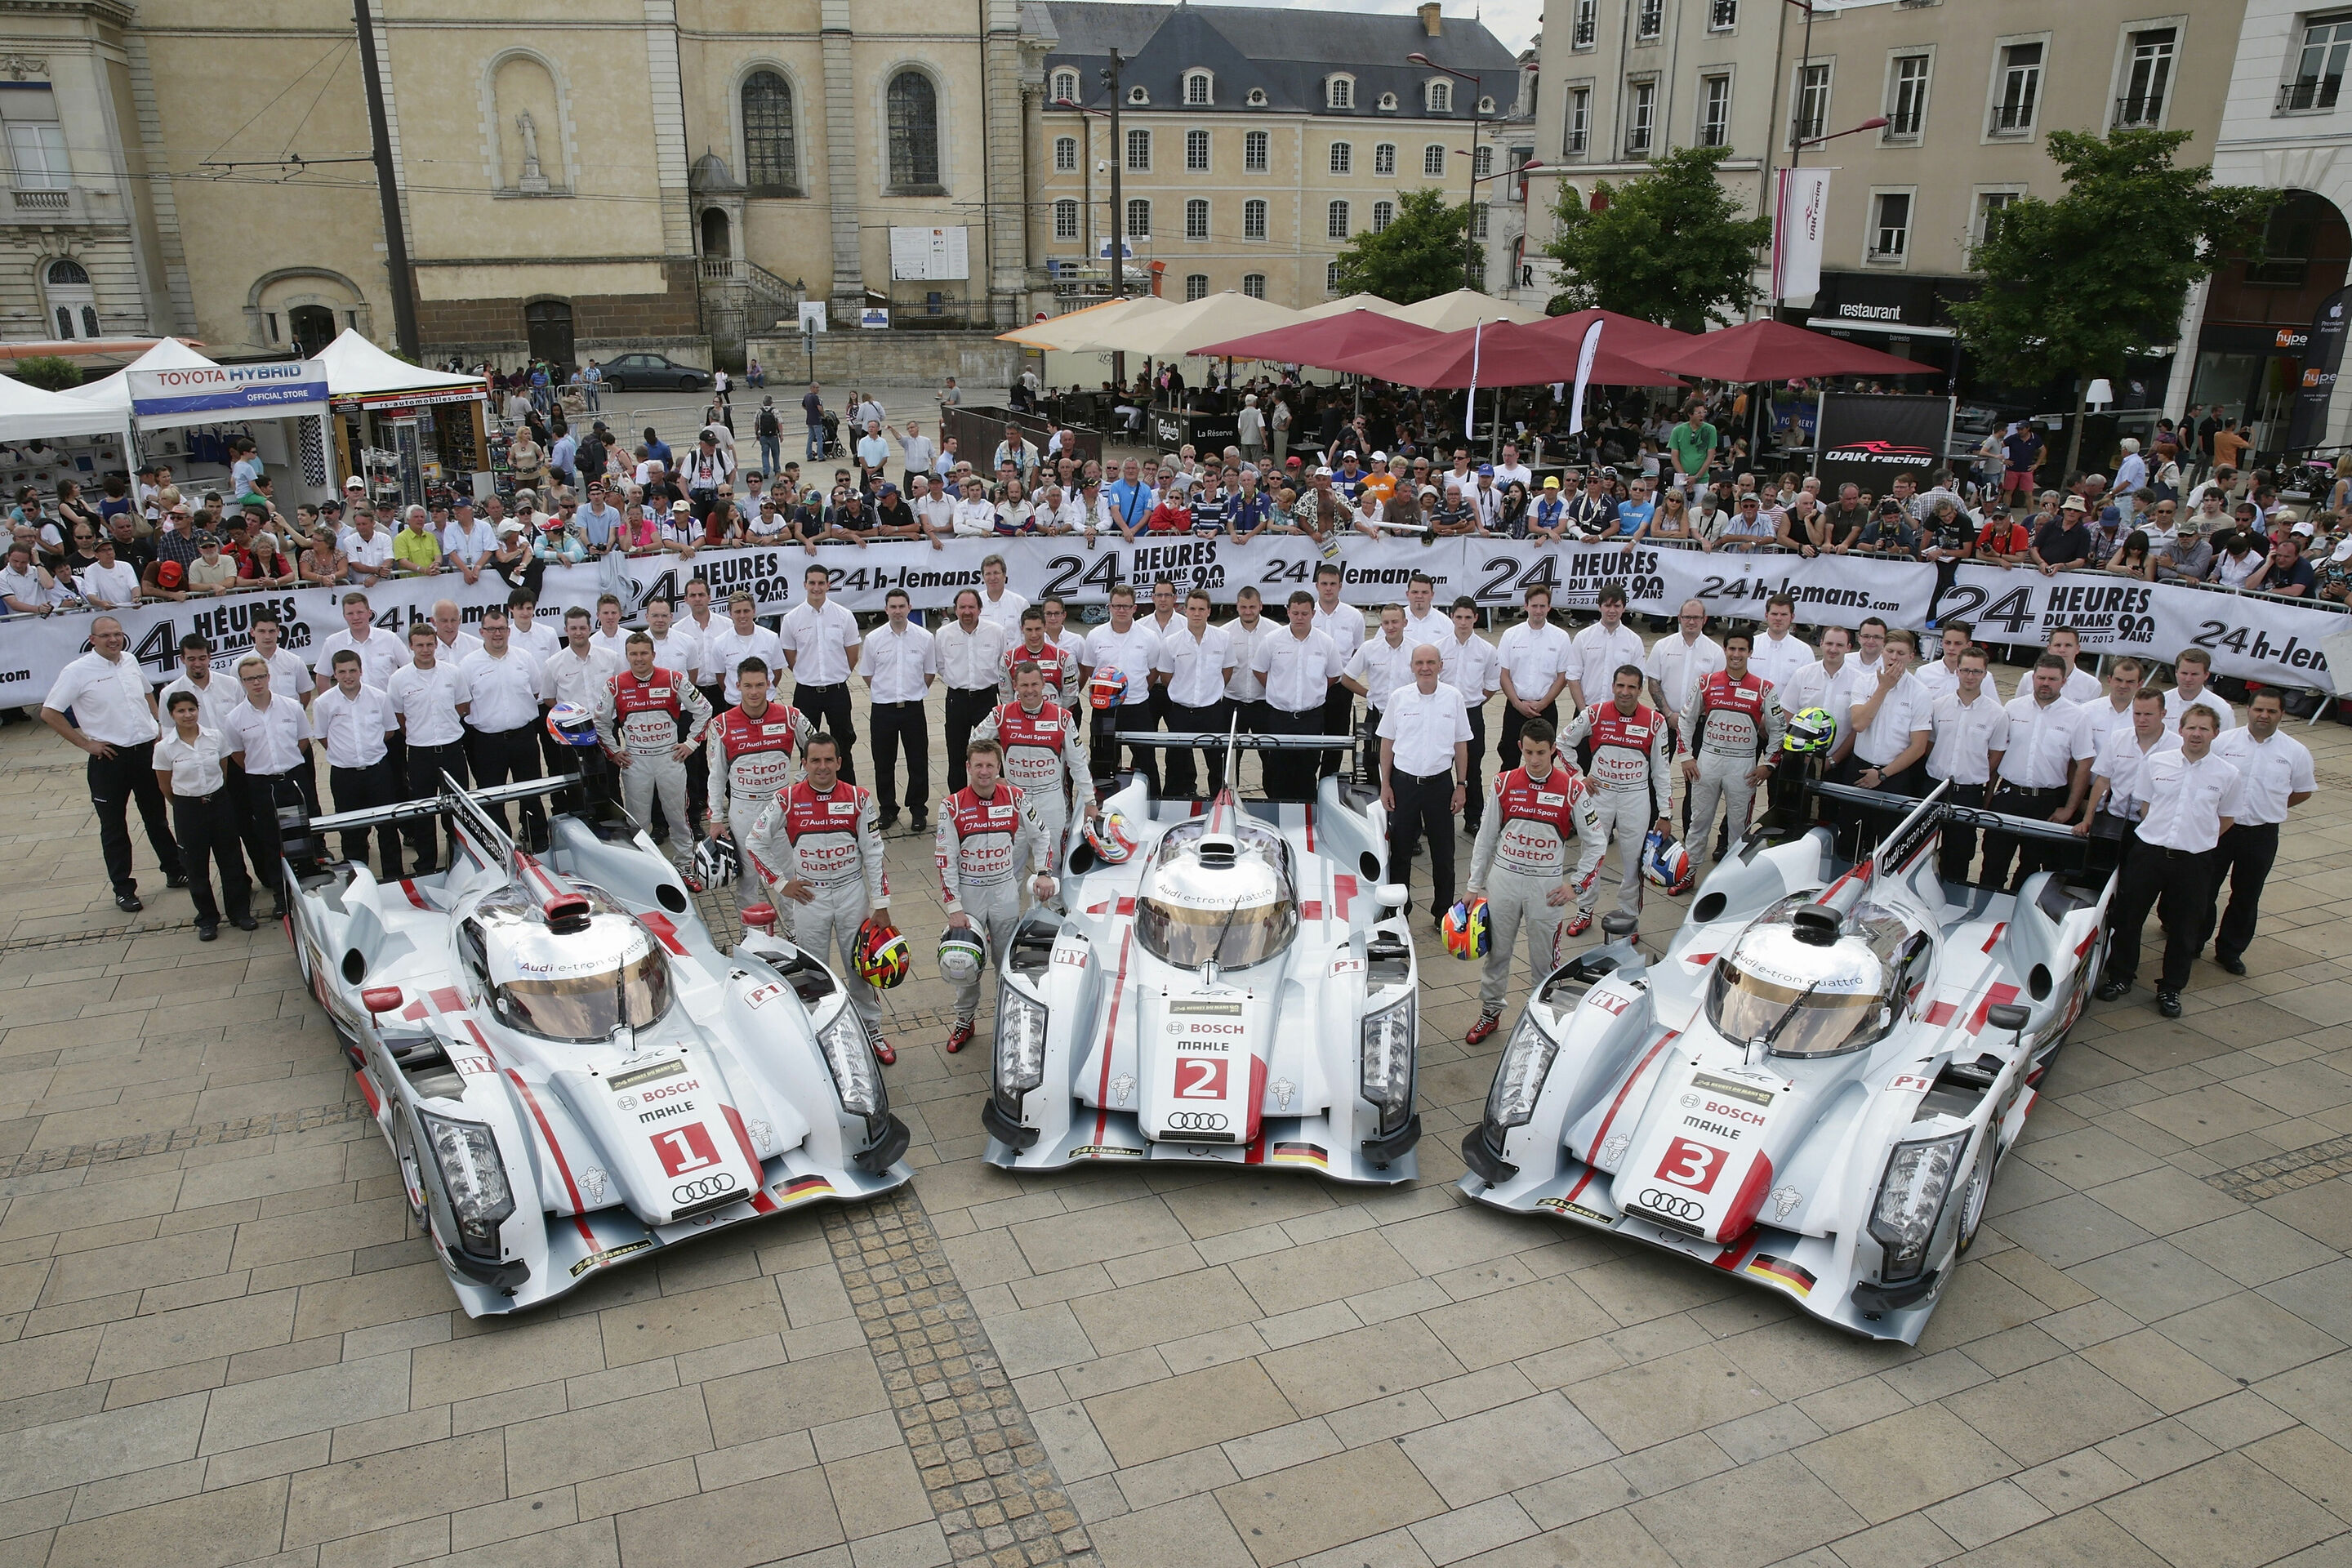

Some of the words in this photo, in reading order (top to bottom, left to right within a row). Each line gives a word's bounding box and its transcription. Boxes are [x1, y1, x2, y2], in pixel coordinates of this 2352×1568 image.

[1814, 180, 1822, 214] racing
[1521, 265, 1534, 287] R
[1839, 303, 1901, 320] restaurant
[1830, 329, 1851, 337] baresto
[2276, 330, 2308, 346] hype
[158, 370, 226, 386] TOYOTA
[229, 364, 302, 381] HYBRID
[2303, 370, 2337, 385] hype
[247, 391, 283, 403] OFFICIAL
[283, 389, 309, 399] STORE
[380, 394, 474, 408] rs-automobiles.com
[1158, 418, 1179, 437] Carlsberg
[1781, 416, 1815, 428] POMERY
[1197, 430, 1205, 438] La
[1207, 429, 1233, 438] Réserve
[1825, 451, 1870, 462] OAK
[1871, 455, 1932, 467] racing
[693, 553, 779, 586] HEURES
[1039, 551, 1126, 599] 24
[1134, 541, 1217, 572] HEURES
[1152, 568, 1188, 583] MANS
[1192, 564, 1224, 590] 90
[1259, 558, 1309, 583] 24
[1313, 560, 1448, 586] lemansom
[1473, 554, 1561, 601] 24
[1571, 551, 1659, 576] HEURES
[828, 568, 870, 592] 24
[873, 567, 1008, 590] h-lemans.
[1133, 573, 1150, 585] DU
[1204, 577, 1224, 589] ANS
[1568, 578, 1587, 590] DU
[1592, 577, 1628, 590] MANS
[755, 577, 789, 603] 90
[767, 588, 789, 602] ANS
[1632, 576, 1664, 599] 90
[1642, 588, 1664, 599] ANS
[1695, 577, 1750, 600] 24
[1751, 577, 1900, 612] h-lemans.com
[1568, 596, 1590, 605] 22-23
[409, 603, 560, 624] h-man.com
[1938, 585, 2037, 634] 24
[2047, 586, 2153, 613] HEURES
[2042, 613, 2066, 627] DU
[2070, 613, 2114, 627] MANS
[2118, 616, 2154, 642] 90
[2128, 629, 2154, 644] ANS
[2190, 620, 2252, 654] 24
[224, 633, 252, 650] MAN
[287, 635, 311, 650] ANS
[2092, 633, 2115, 644] 2013
[627, 721, 670, 733] e-tron
[1707, 720, 1751, 733] e-tron
[629, 732, 671, 743] quattro
[1707, 731, 1750, 743] quattro
[737, 762, 786, 775] e-tron
[1009, 757, 1054, 768] e-tron
[1597, 756, 1643, 769] e-tron
[737, 773, 786, 786] quattro
[1009, 768, 1055, 779] quattro
[1597, 768, 1642, 780] quattro
[1537, 809, 1558, 817] Sport
[464, 811, 482, 838] e-tron
[482, 831, 506, 865] quattro
[1505, 831, 1557, 849] e-tron
[1882, 844, 1900, 875] Audi
[1900, 827, 1919, 855] e-tron
[1920, 804, 1943, 835] quattro
[800, 844, 855, 859] e-tron
[960, 845, 1011, 859] e-tron
[1502, 844, 1555, 862] quattro
[801, 857, 856, 871] quattro
[960, 859, 1010, 872] quattro
[1157, 883, 1182, 899] Audi
[1183, 894, 1223, 905] e-tron
[1230, 888, 1272, 906] quattro
[520, 962, 554, 973] Audi
[558, 959, 605, 972] e-tron
[608, 938, 644, 963] quattro
[1055, 949, 1086, 967] HY
[1334, 960, 1360, 973] P1
[1735, 949, 1757, 968] Audi
[1758, 965, 1802, 984] e-tron
[1807, 976, 1864, 987] quattro
[751, 985, 780, 1003] P1
[1591, 991, 1628, 1013] HY
[1191, 1024, 1244, 1034] BOSCH
[1178, 1041, 1229, 1051] MAHLE
[457, 1057, 493, 1075] HY
[1183, 1060, 1218, 1098] 2
[1894, 1077, 1927, 1089] P1
[642, 1080, 700, 1104] BOSCH
[639, 1101, 695, 1124] MAHLE
[1705, 1101, 1766, 1126] BOSCH
[1683, 1116, 1741, 1140] MAHLE
[662, 1129, 710, 1172] 1
[1666, 1143, 1714, 1185] 3
